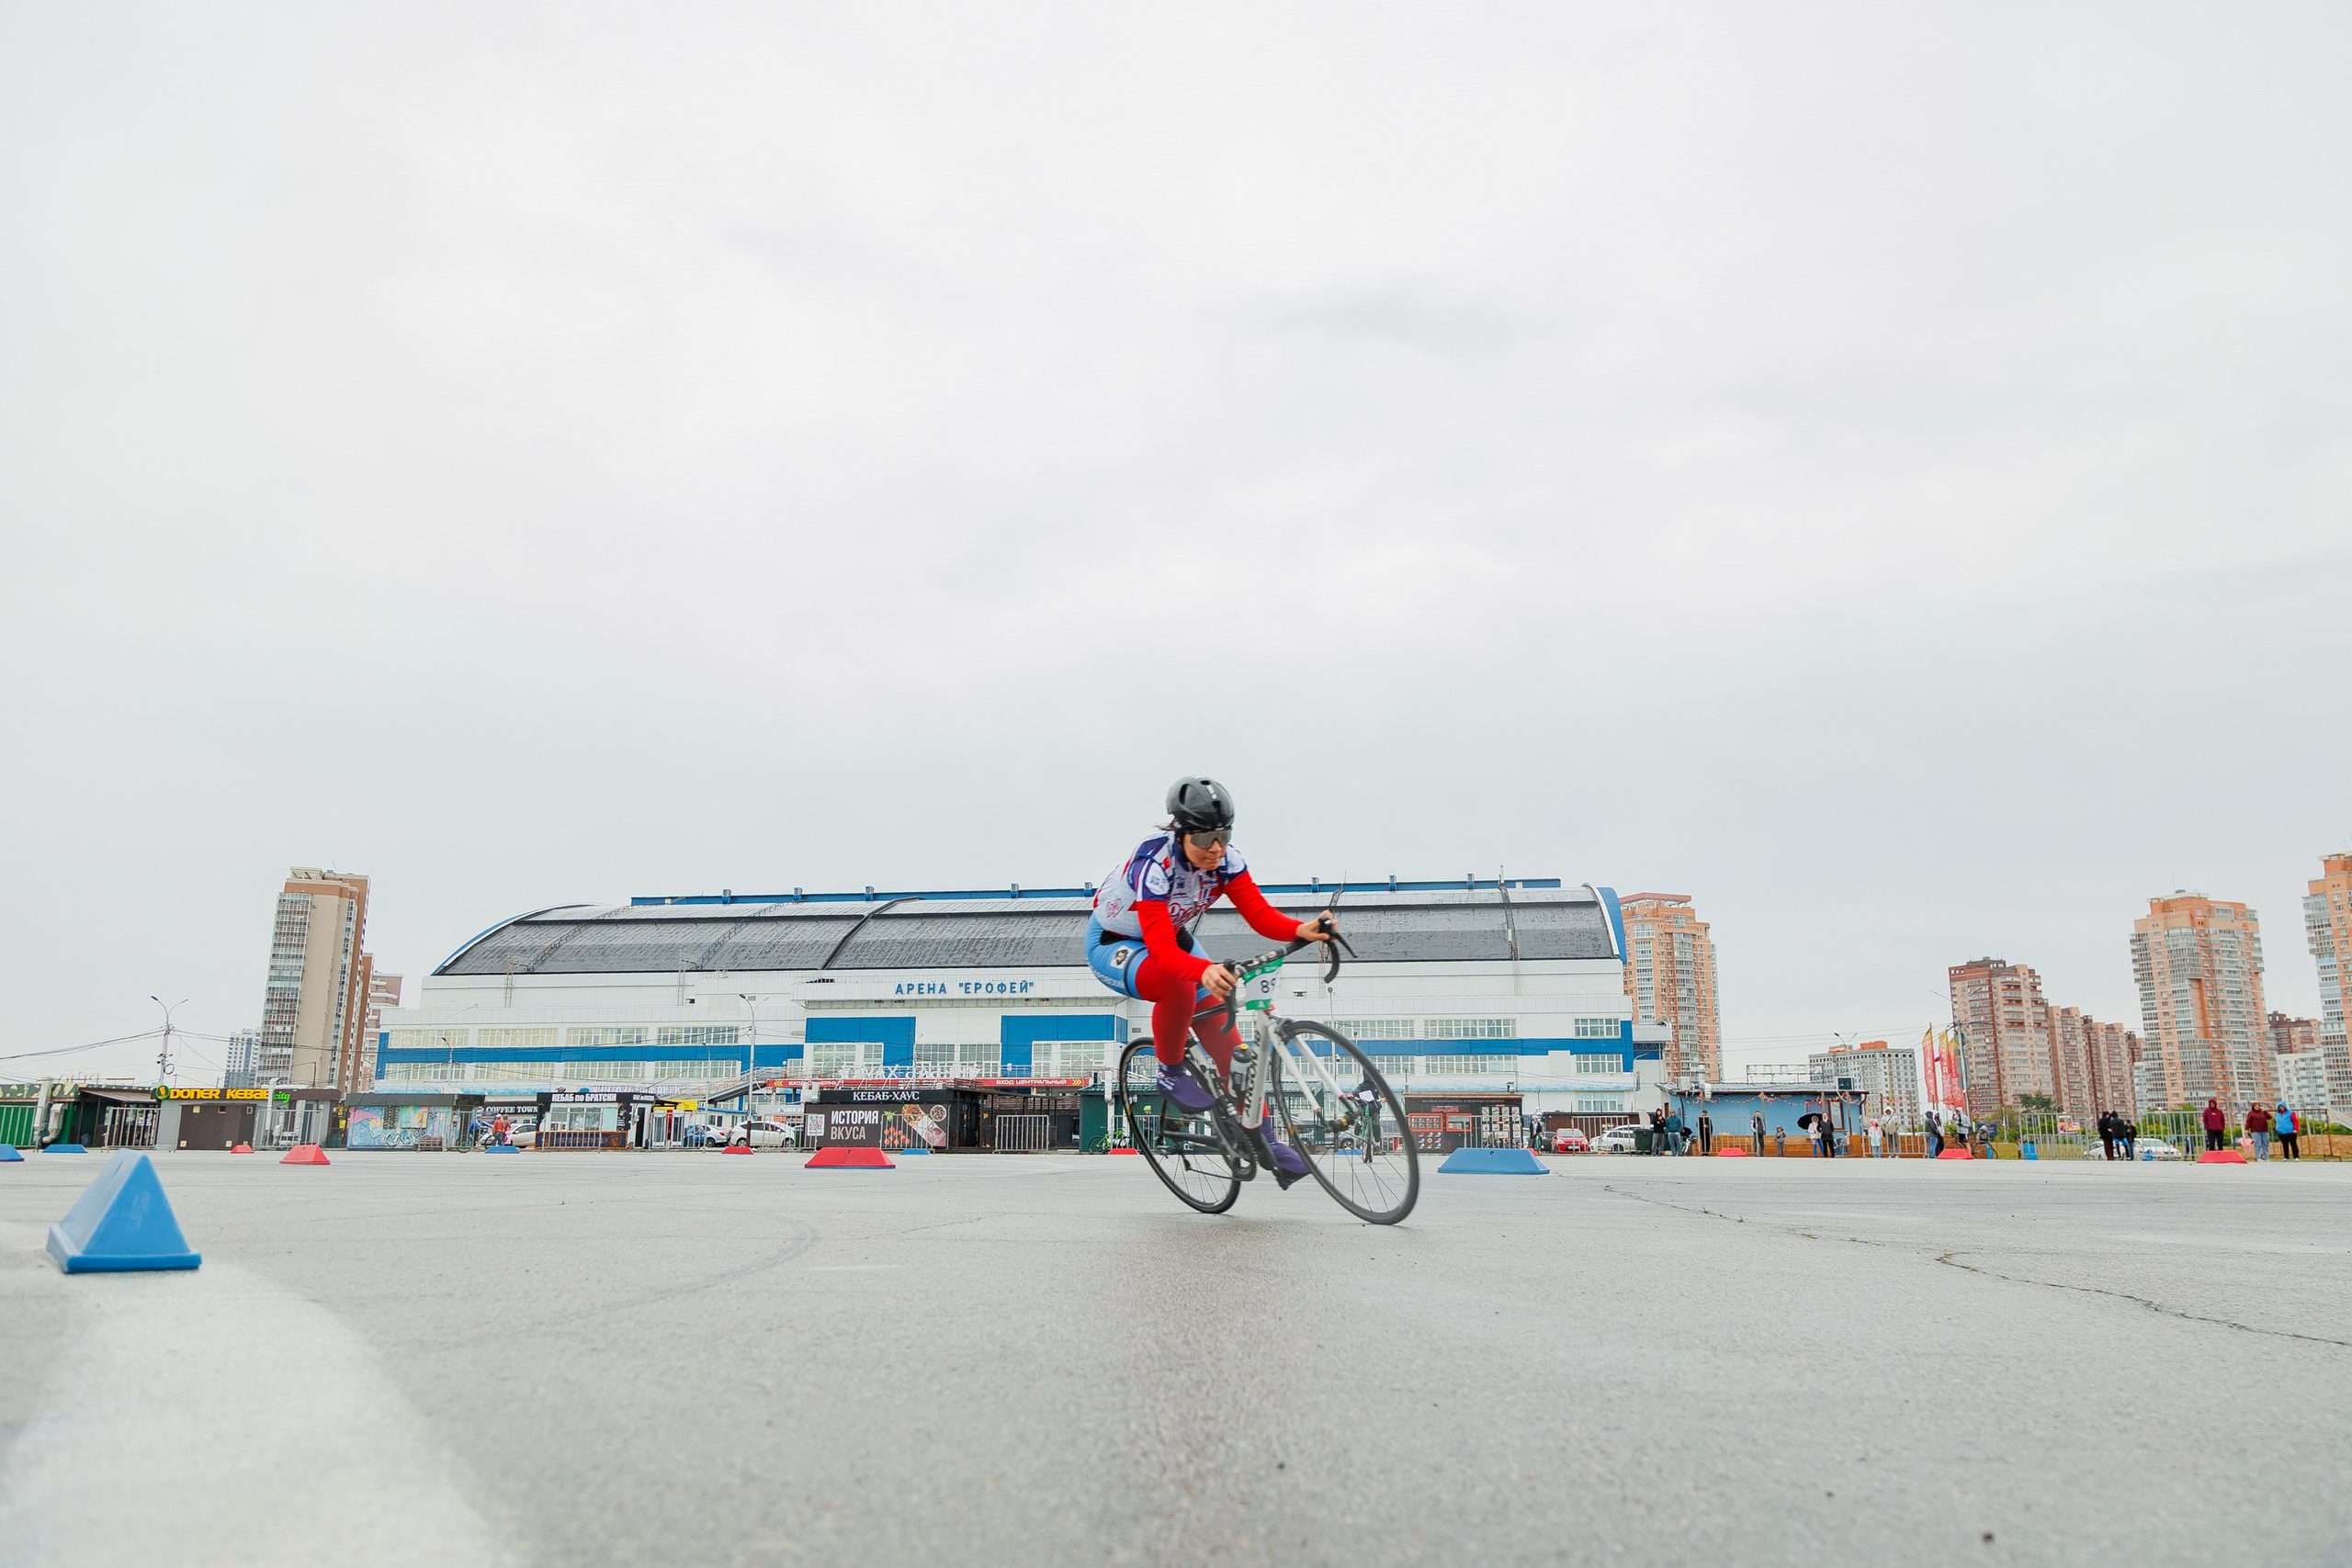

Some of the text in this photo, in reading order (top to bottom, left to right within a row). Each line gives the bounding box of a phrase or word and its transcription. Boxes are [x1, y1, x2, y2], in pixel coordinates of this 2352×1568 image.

[895, 980, 1034, 995] АРЕНА "ЕРОФЕЙ"
[552, 1093, 574, 1102] КЕБАБ
[585, 1093, 616, 1102] БРАТСКИ
[853, 1091, 920, 1100] КЕБАБ-ХАУС
[831, 1111, 879, 1124] ИСТОРИЯ
[831, 1126, 865, 1139] ВКУСА
